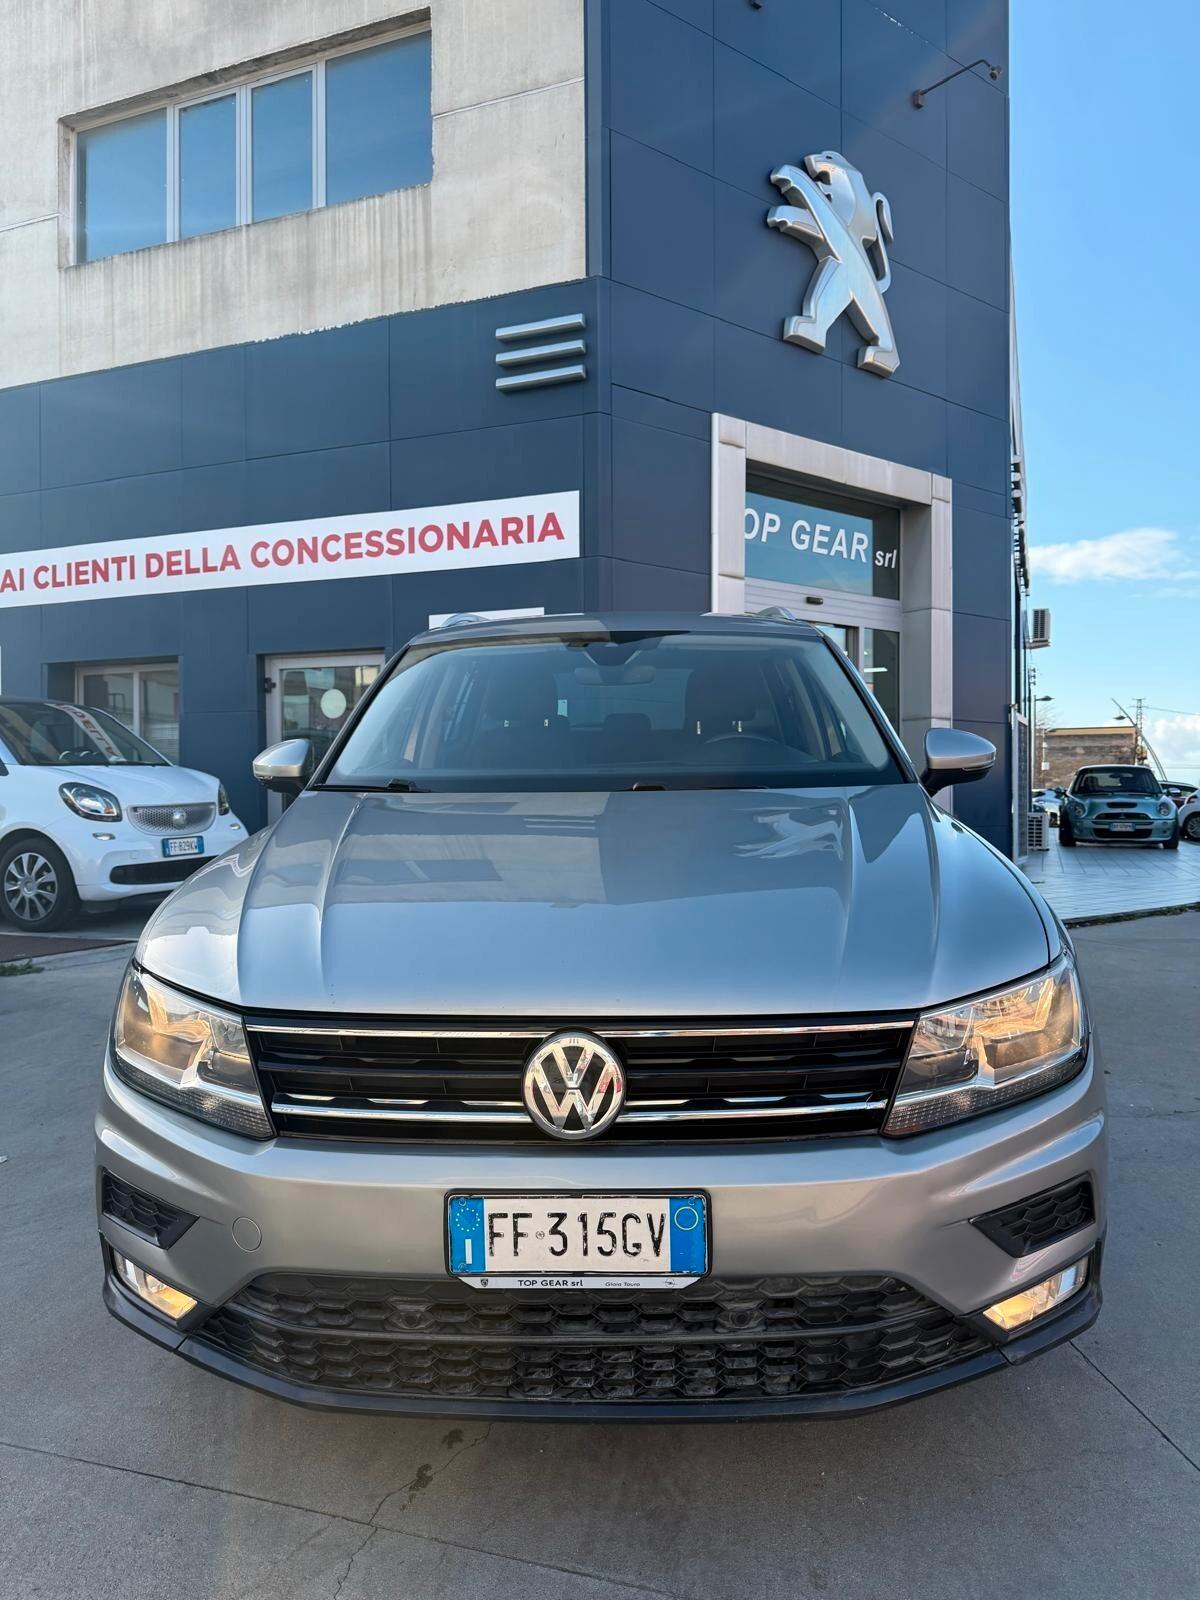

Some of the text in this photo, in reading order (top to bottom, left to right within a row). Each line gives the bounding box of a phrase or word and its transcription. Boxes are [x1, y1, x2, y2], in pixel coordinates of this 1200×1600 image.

[0, 511, 565, 592] AI CLIENTI DELLA CONCESSIONARIA
[744, 508, 897, 568] OP GEAR srl
[488, 1212, 533, 1257] FF
[547, 1212, 666, 1257] 315GV
[517, 1279, 538, 1288] TOP
[540, 1279, 569, 1288] GEAR
[571, 1279, 584, 1288] srl
